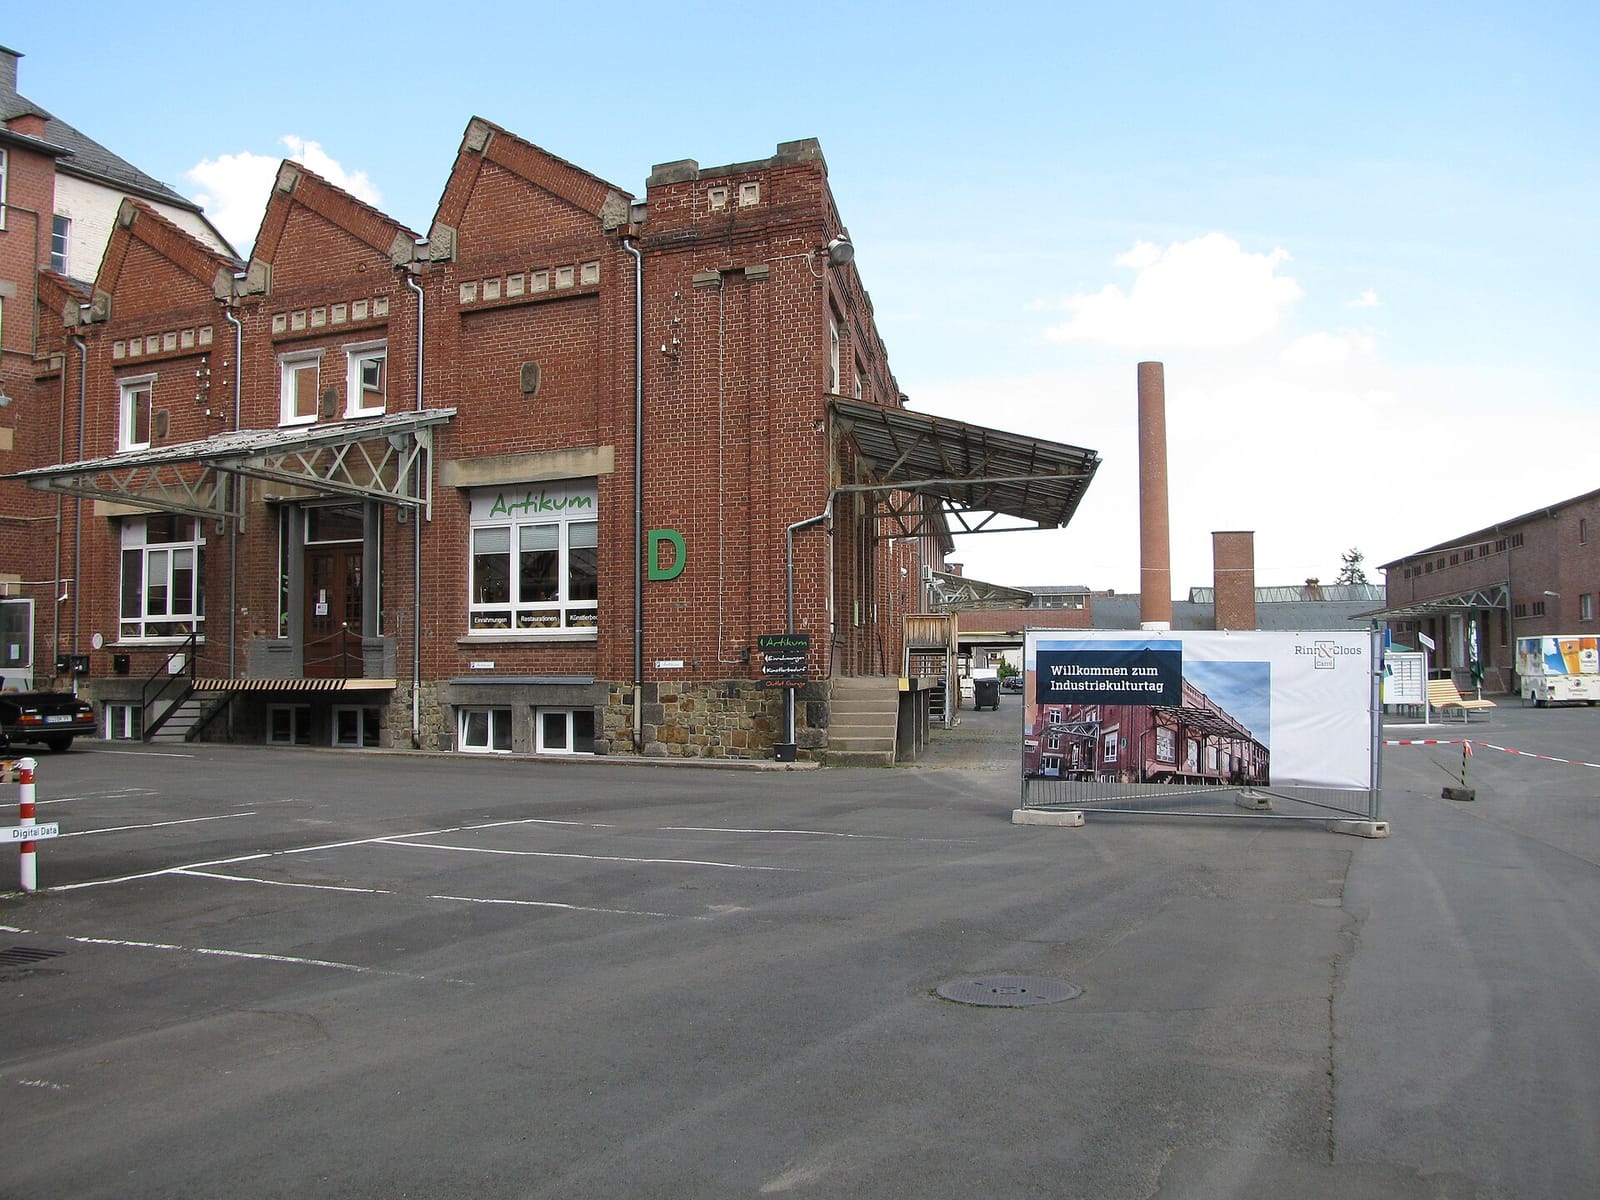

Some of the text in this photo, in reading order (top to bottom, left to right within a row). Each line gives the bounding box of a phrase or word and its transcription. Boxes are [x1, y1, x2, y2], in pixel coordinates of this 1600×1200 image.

[489, 489, 592, 518] Artikum
[647, 528, 687, 581] D
[474, 616, 508, 624] Einrahmungen
[766, 637, 807, 647] Artikum
[1050, 665, 1159, 676] Willkommen zum
[1050, 680, 1164, 693] Industriekulturtag
[12, 826, 57, 839] Digital Data
